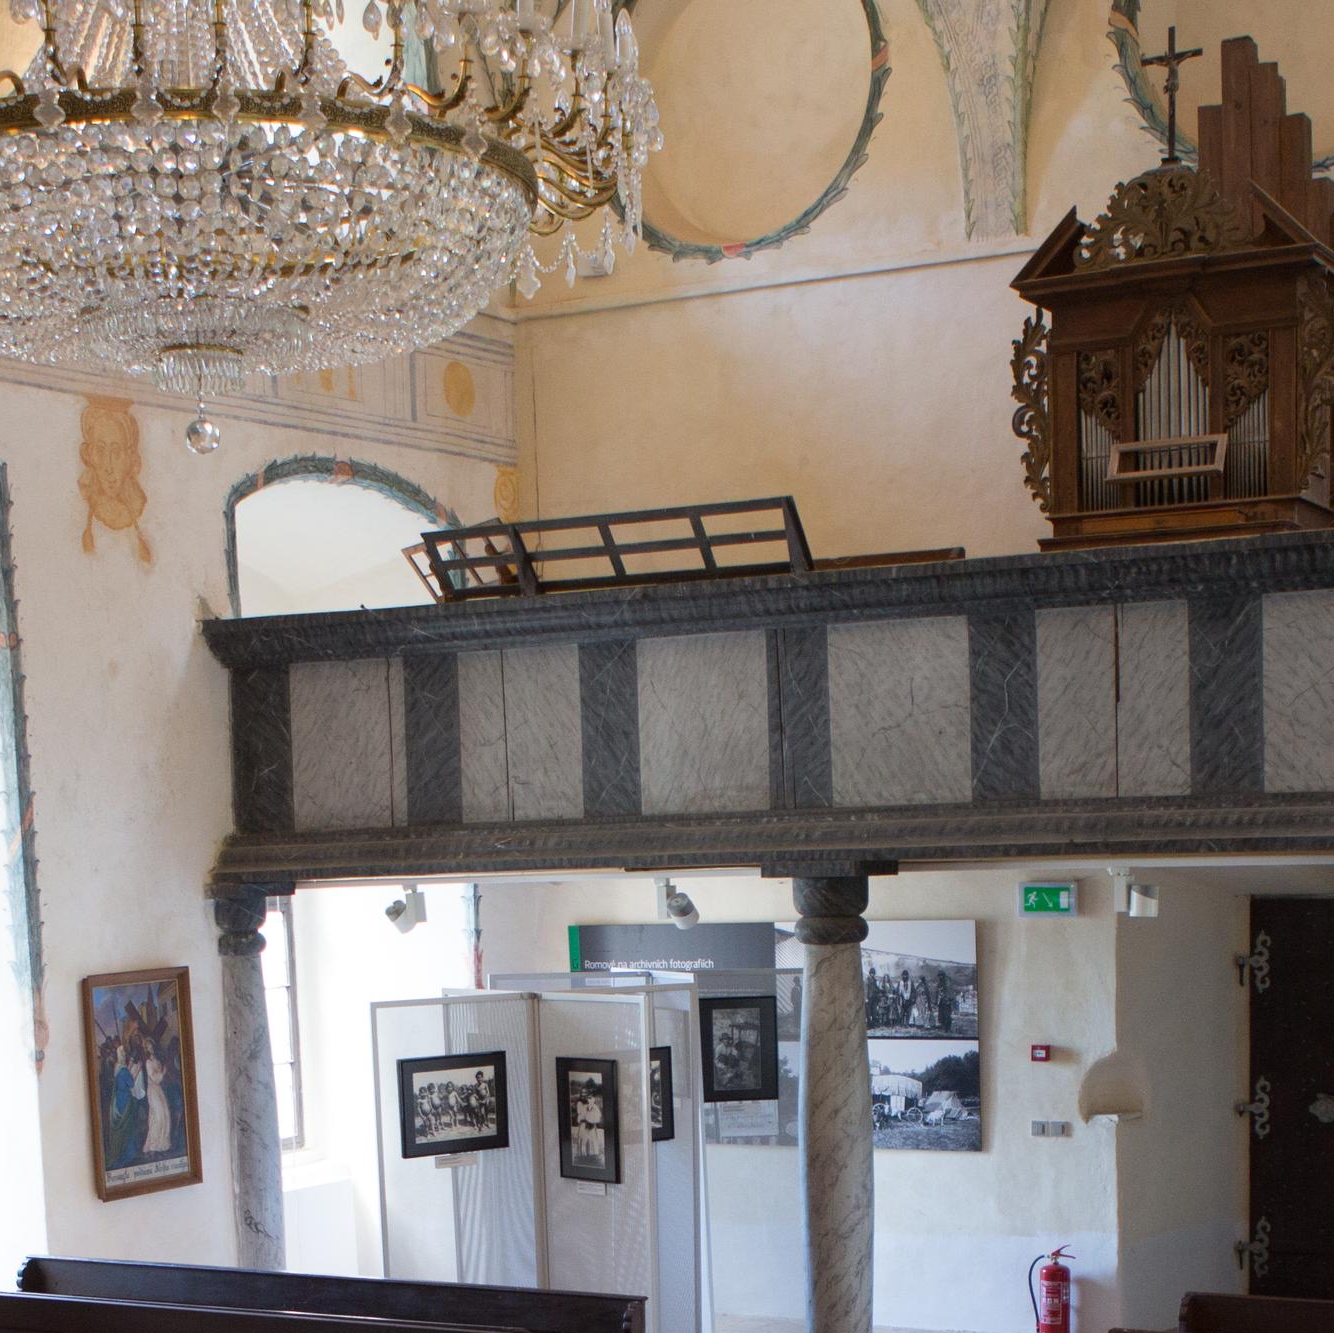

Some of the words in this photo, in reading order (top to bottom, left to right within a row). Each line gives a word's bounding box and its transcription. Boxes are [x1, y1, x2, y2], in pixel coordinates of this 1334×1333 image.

[584, 959, 615, 969] Romové
[629, 958, 667, 969] archivních
[669, 958, 715, 971] fotografiích
